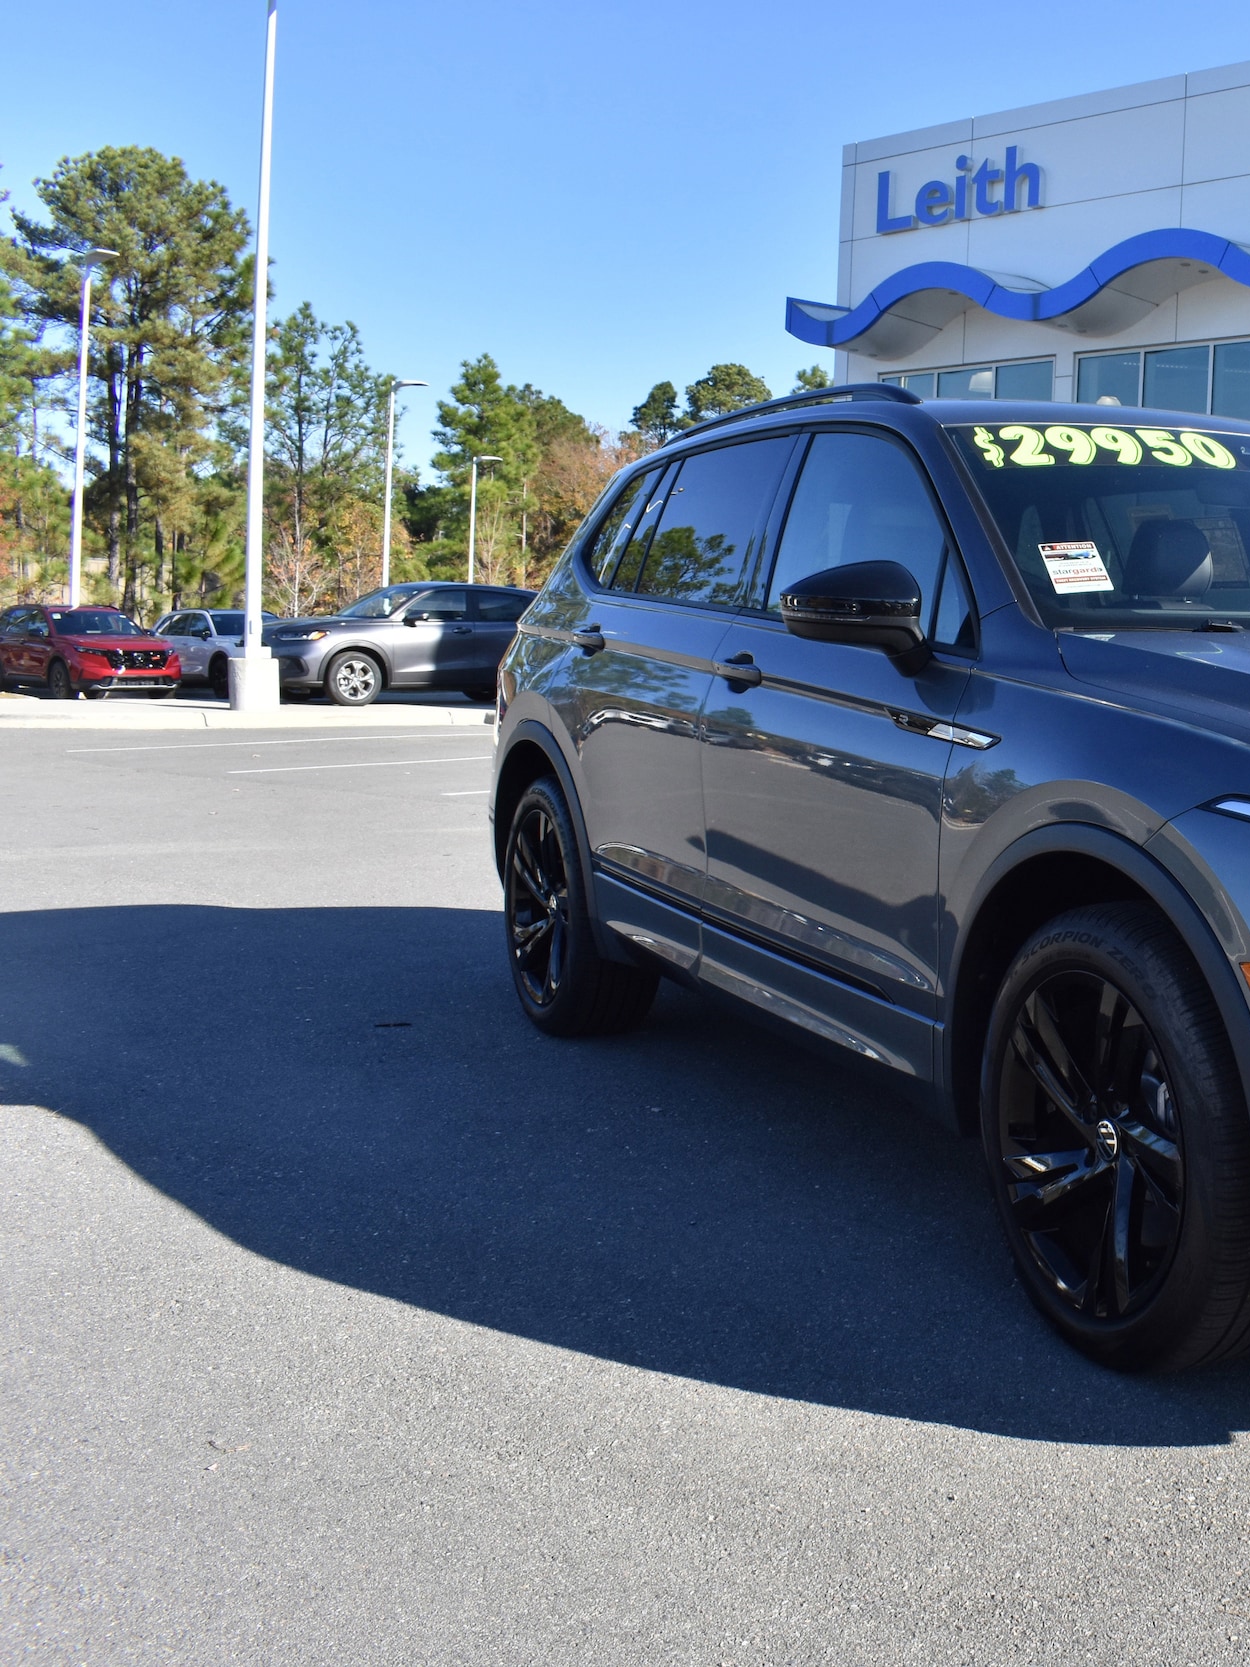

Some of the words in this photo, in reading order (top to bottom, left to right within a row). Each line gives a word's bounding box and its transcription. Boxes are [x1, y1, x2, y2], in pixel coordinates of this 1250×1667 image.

[876, 145, 1043, 234] Leith
[973, 425, 1237, 469] $29950
[1021, 930, 1103, 966] SCORPION
[1106, 945, 1158, 999] ZERO
